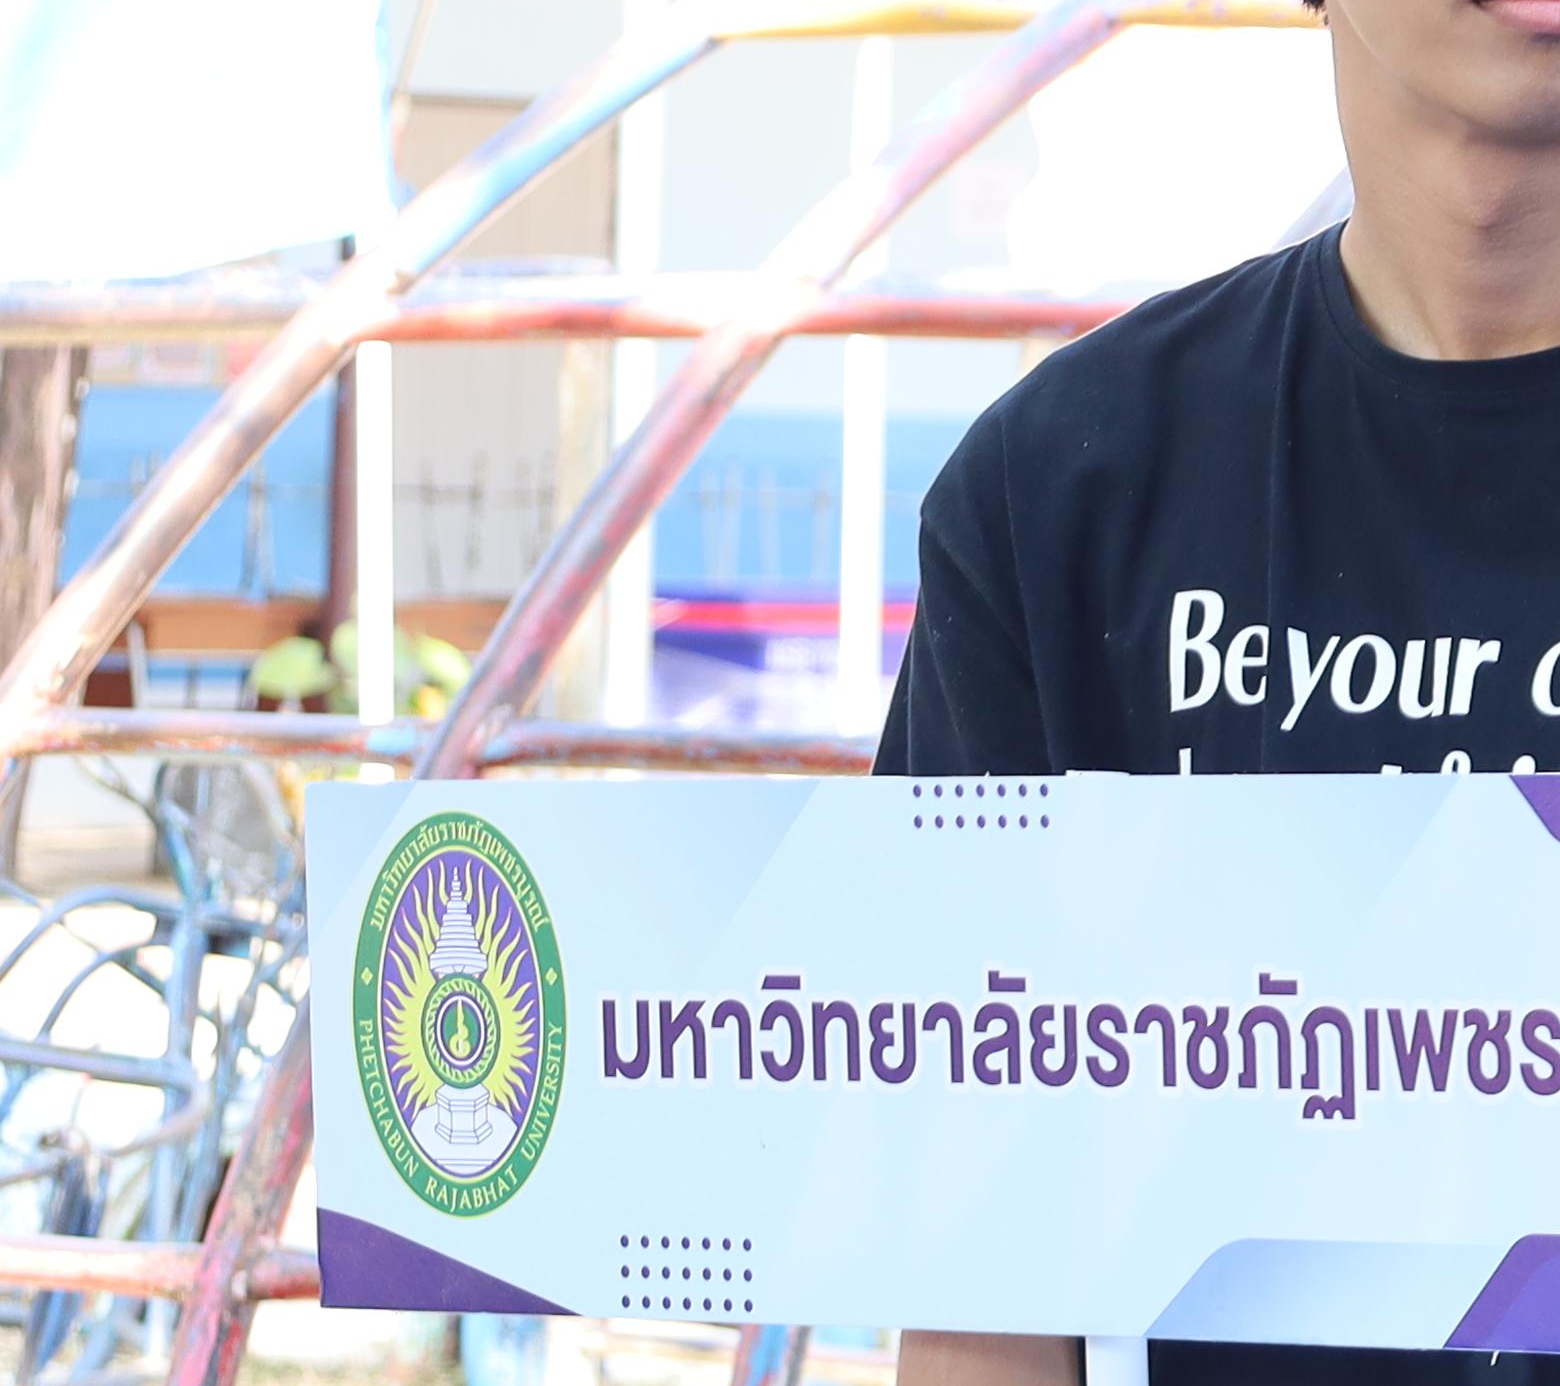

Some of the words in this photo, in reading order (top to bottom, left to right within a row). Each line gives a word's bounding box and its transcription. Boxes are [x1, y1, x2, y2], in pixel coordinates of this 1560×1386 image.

[1169, 589, 1269, 712] Be
[1281, 627, 1501, 731] your
[358, 1019, 420, 1179] PHETCHABUN
[425, 1169, 519, 1212] RAJABHAT
[521, 1022, 563, 1161] UNIVERSITY
